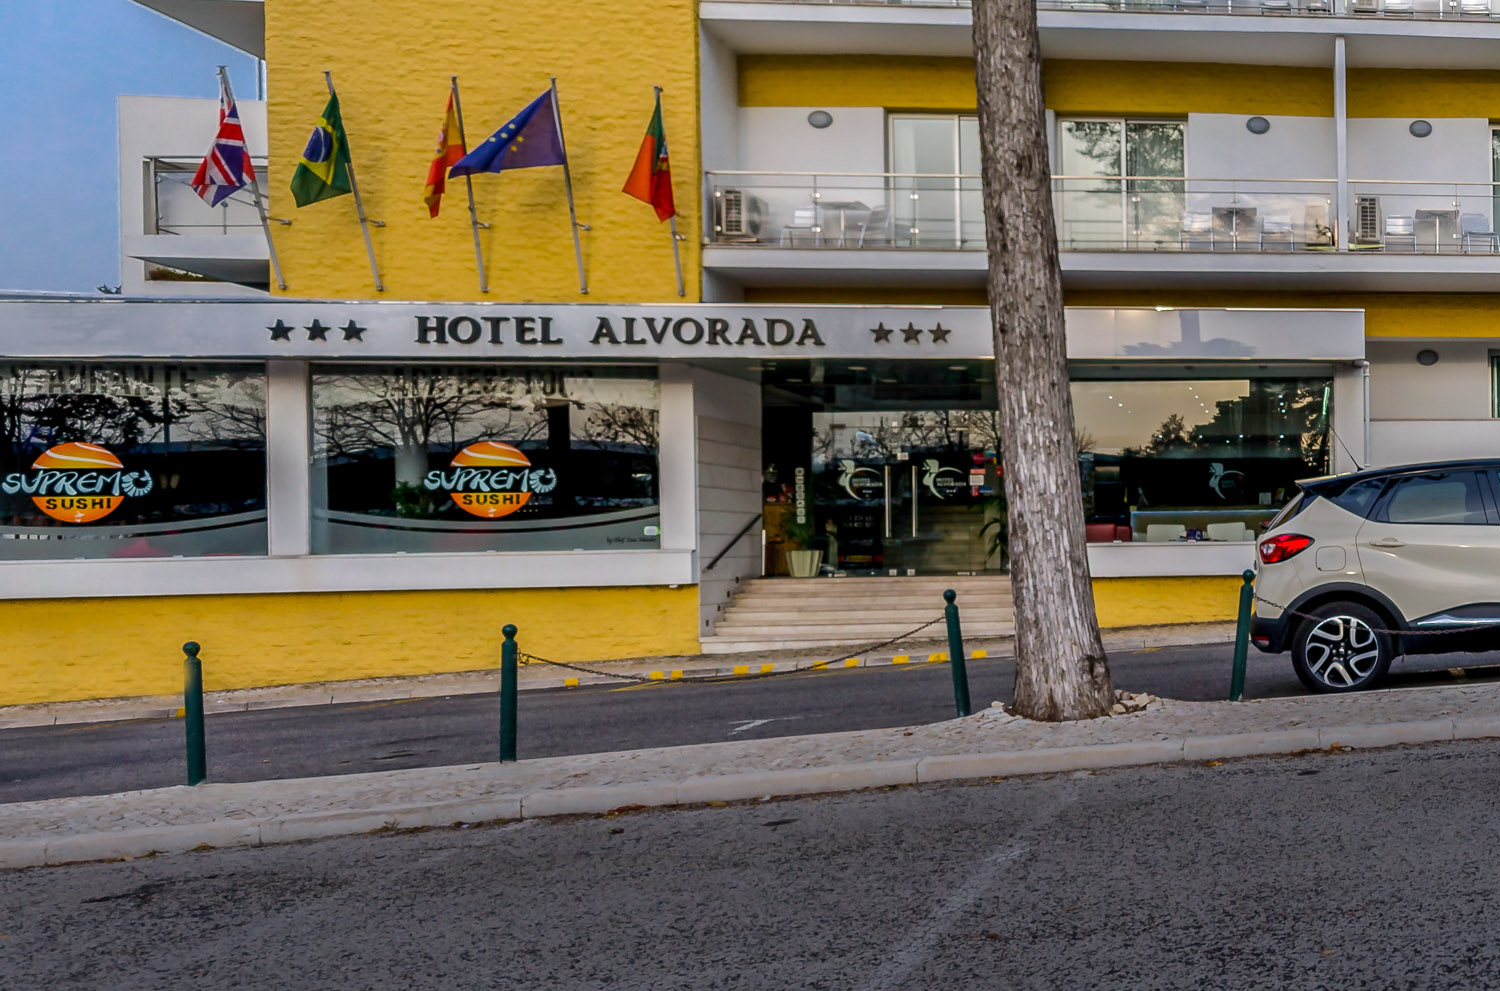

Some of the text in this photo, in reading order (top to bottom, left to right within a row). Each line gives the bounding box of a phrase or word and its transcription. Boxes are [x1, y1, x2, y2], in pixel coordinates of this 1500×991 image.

[414, 315, 826, 346] HOTEL ALVORADA
[1, 470, 154, 497] SUPREMO
[424, 467, 557, 494] SUPREMO
[46, 498, 111, 509] SUSHI
[462, 494, 520, 505] SUSHI
